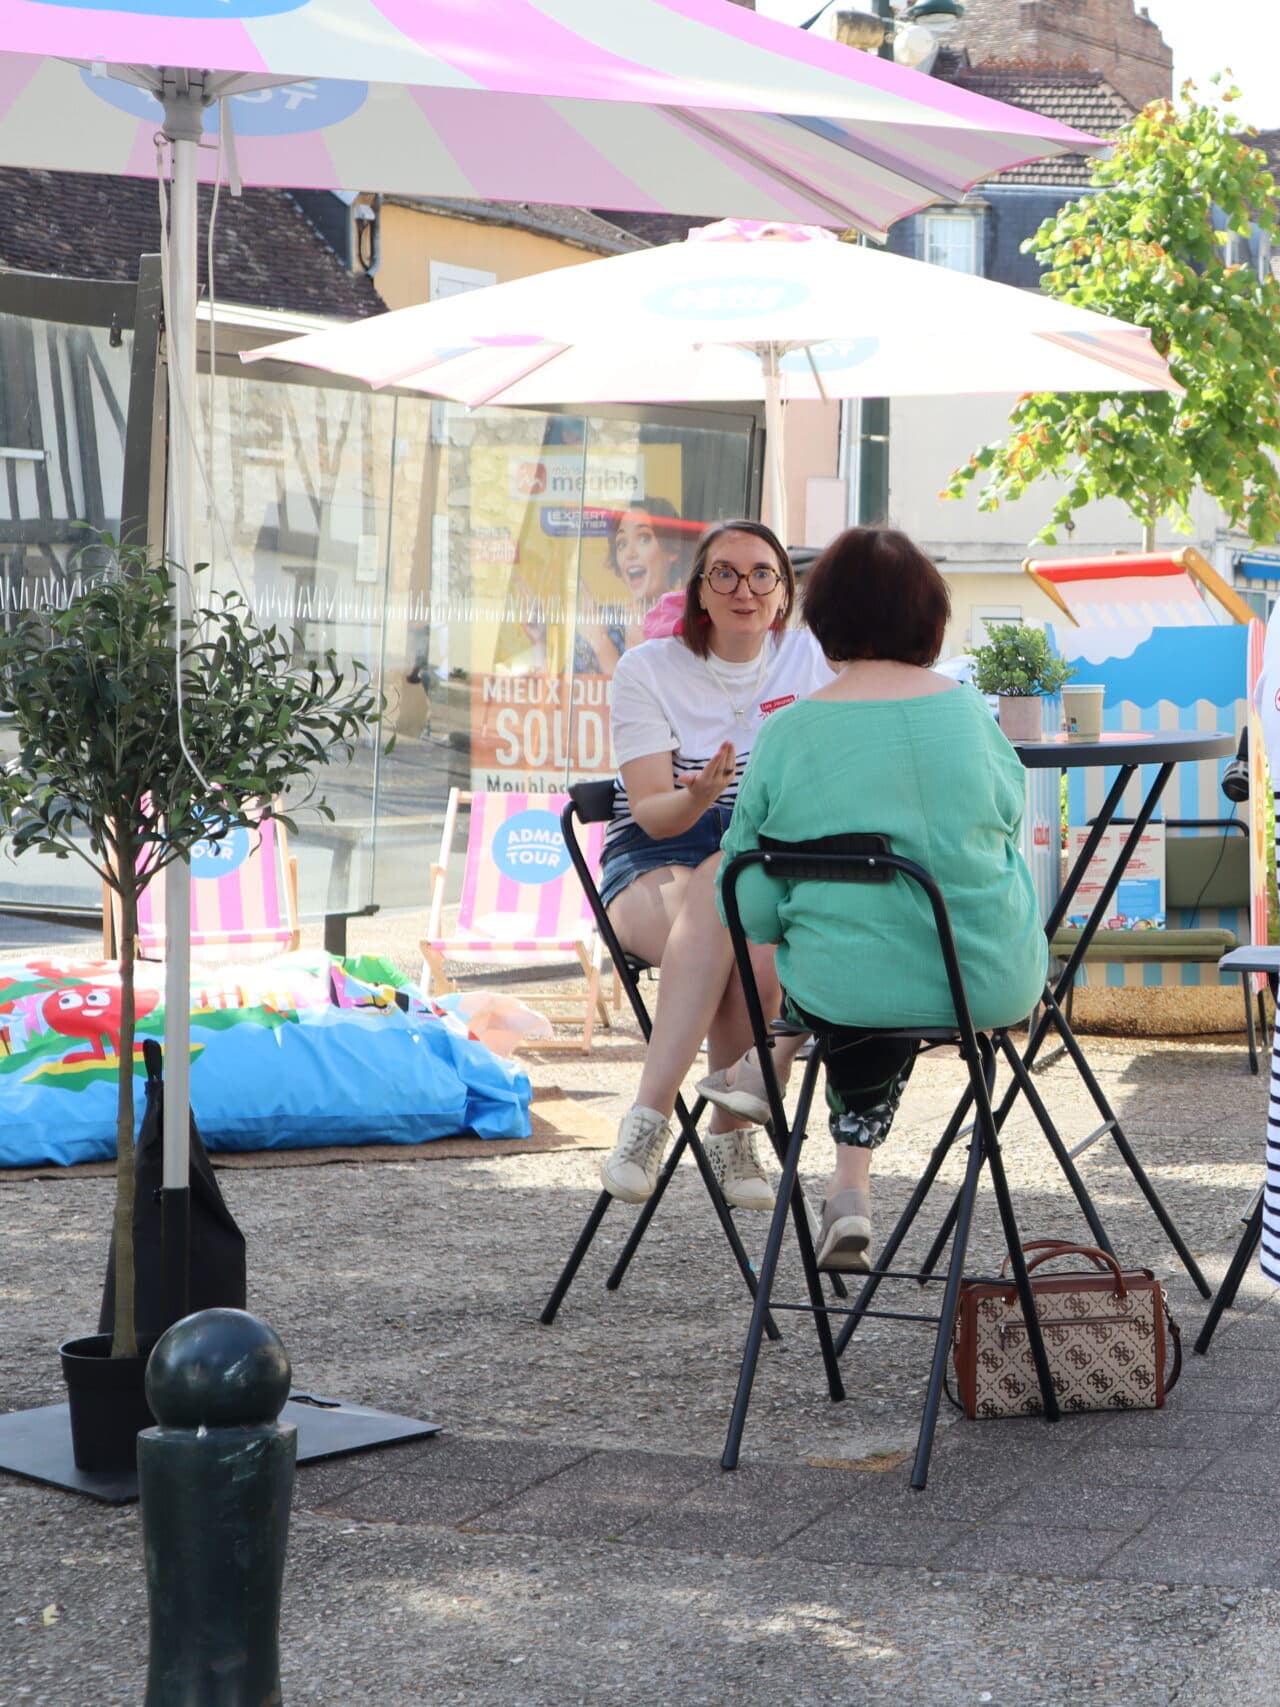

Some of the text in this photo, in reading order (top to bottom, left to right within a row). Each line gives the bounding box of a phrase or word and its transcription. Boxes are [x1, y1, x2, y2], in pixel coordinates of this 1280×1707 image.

[552, 469, 639, 492] meuble
[483, 677, 613, 705] MIEUX QU
[508, 829, 564, 846] ADMD
[191, 845, 234, 860] OUR
[506, 851, 561, 868] TOUR
